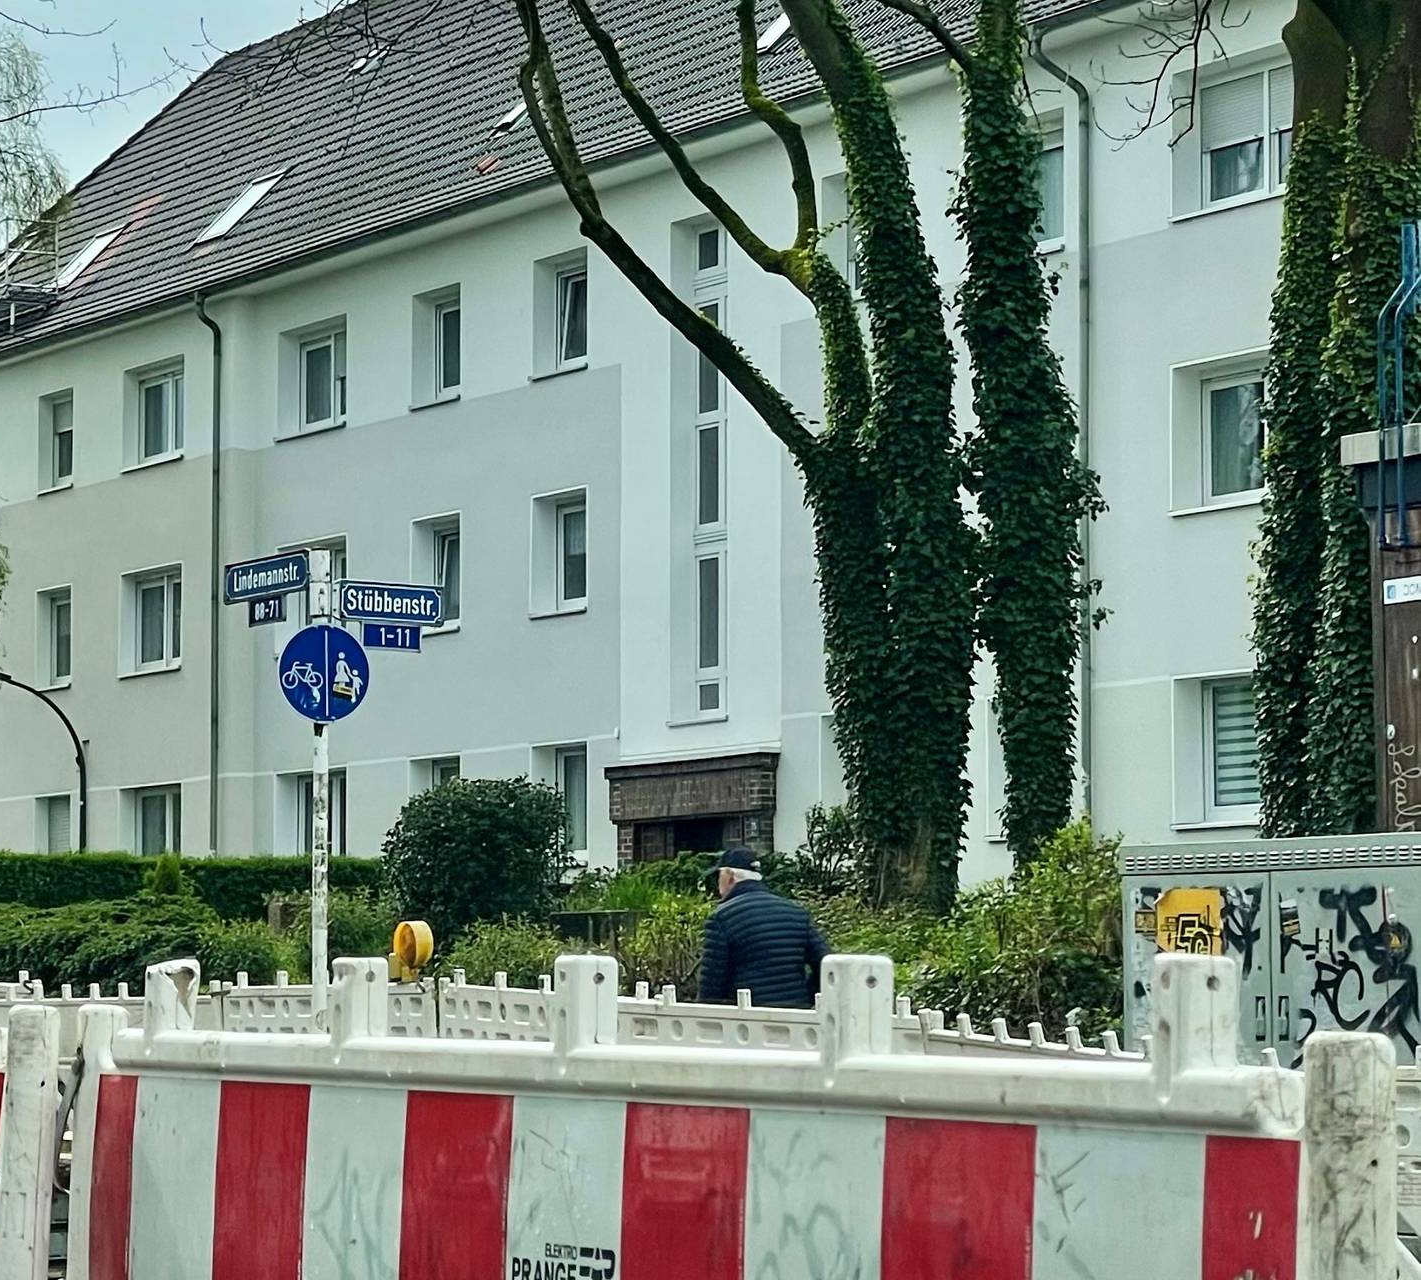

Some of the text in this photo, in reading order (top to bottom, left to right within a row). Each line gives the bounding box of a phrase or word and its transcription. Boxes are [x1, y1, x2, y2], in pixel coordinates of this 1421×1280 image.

[233, 562, 300, 593] Lindemannstr.
[254, 599, 280, 621] 88-71
[347, 588, 437, 616] Stübbenstr.
[379, 626, 410, 648] 1-11
[545, 1242, 578, 1261] ELEKTRO
